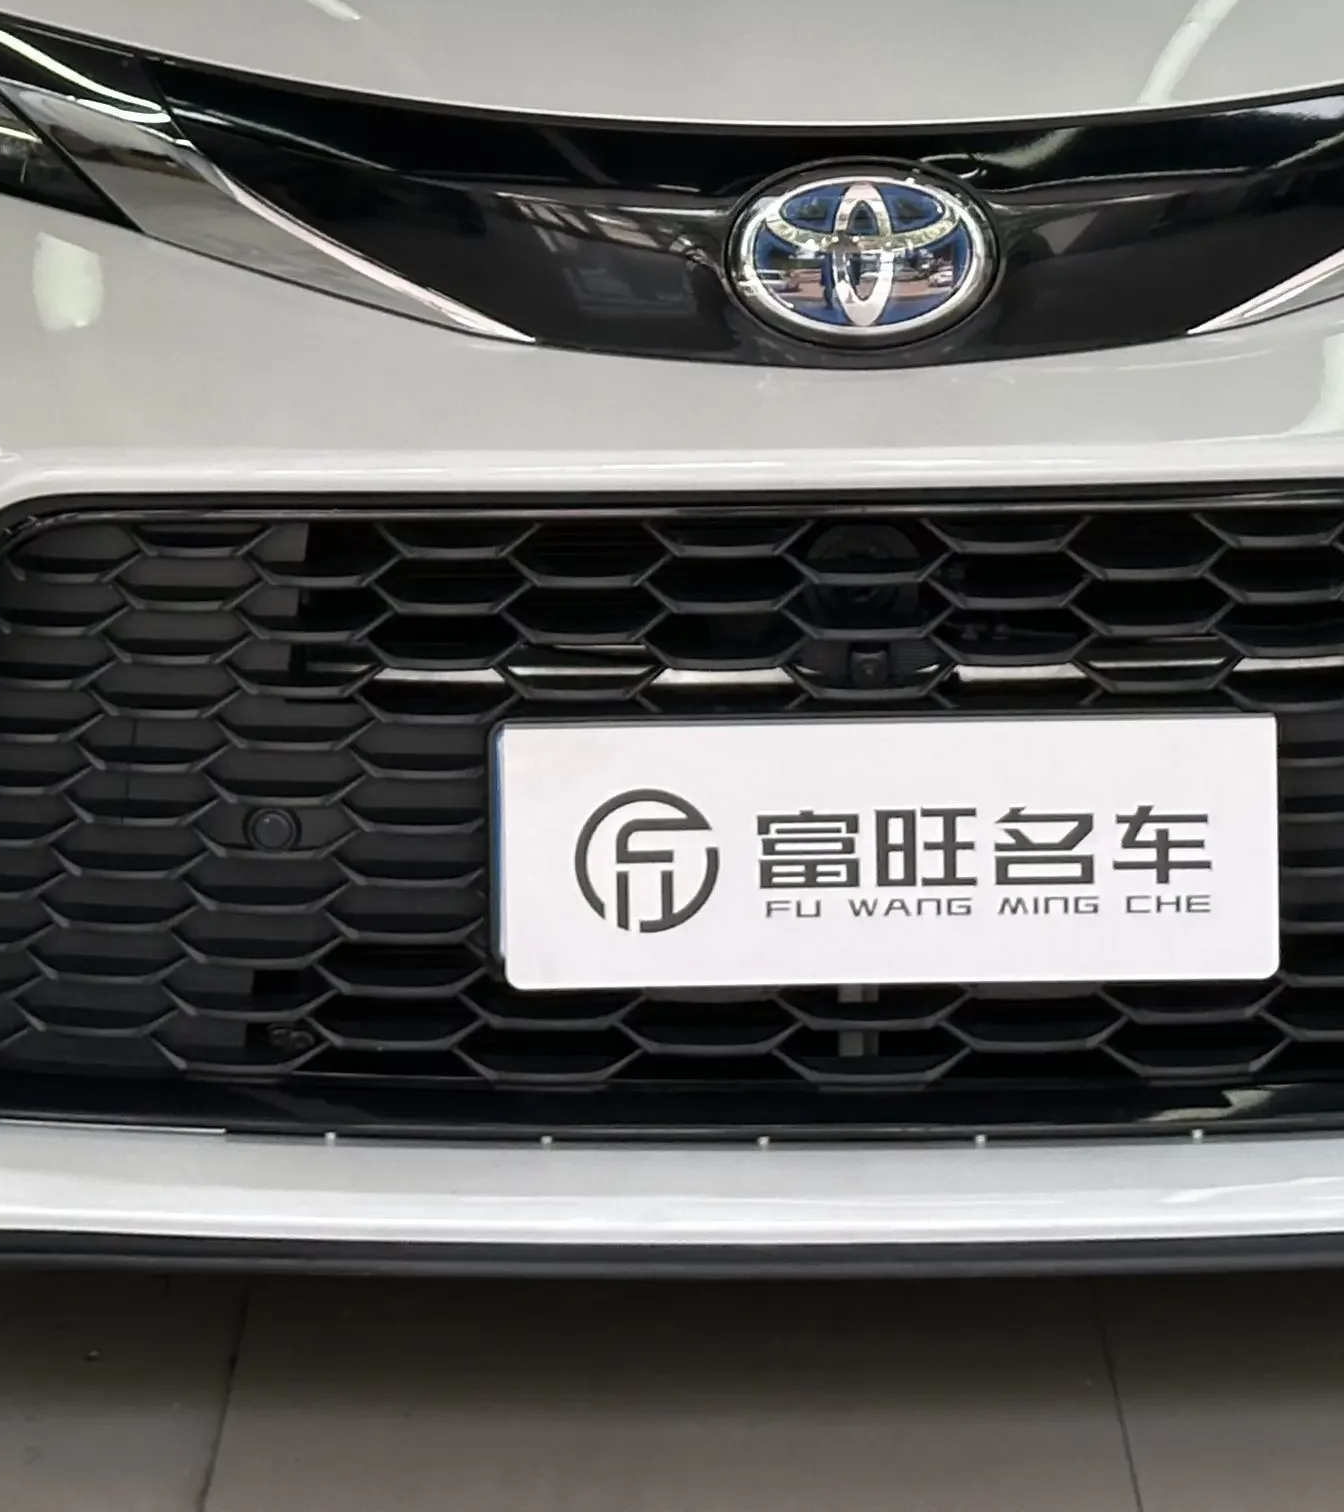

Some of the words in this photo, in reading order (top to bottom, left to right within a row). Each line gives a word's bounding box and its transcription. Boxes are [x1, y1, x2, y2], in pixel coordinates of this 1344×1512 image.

[756, 804, 1214, 889] 富旺名车
[765, 899, 822, 918] FU
[848, 898, 973, 917] WANG
[997, 896, 1100, 915] MING
[1125, 894, 1212, 914] CHE
